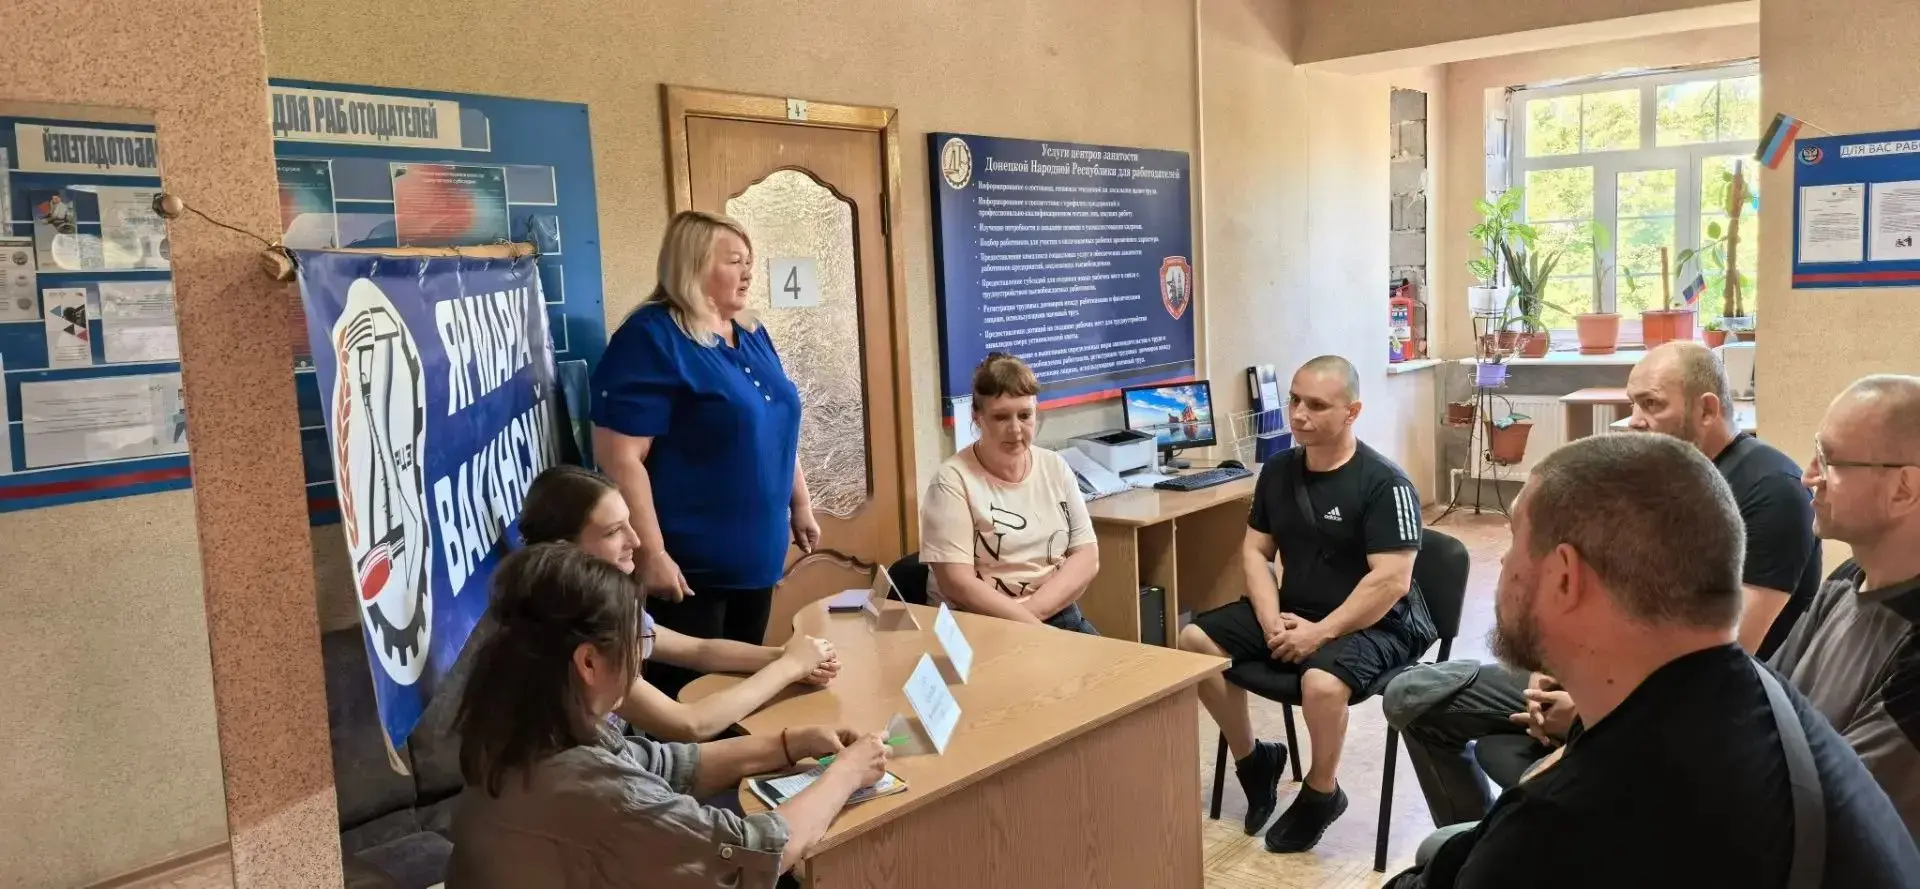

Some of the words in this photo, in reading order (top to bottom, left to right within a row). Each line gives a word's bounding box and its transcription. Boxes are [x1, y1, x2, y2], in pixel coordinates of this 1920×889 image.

[272, 94, 311, 137] ДЛЯ
[313, 96, 438, 140] РАБОТОДАТЕЛЕЙ
[795, 104, 801, 117] 4
[1042, 144, 1070, 159] Услуги
[1071, 150, 1101, 161] центров
[1103, 151, 1139, 162] занятости
[1842, 145, 1865, 156] ДЛЯ
[1869, 143, 1891, 153] ВАС
[985, 156, 1029, 173] Донецкой
[1031, 160, 1070, 176] Народной
[1072, 162, 1117, 178] Республики
[1117, 168, 1130, 178] для
[1132, 166, 1180, 180] работодателей
[783, 265, 801, 300] 4
[435, 287, 533, 417] ЯРМАРКА
[434, 382, 556, 597] ВАКАНСИЙ
